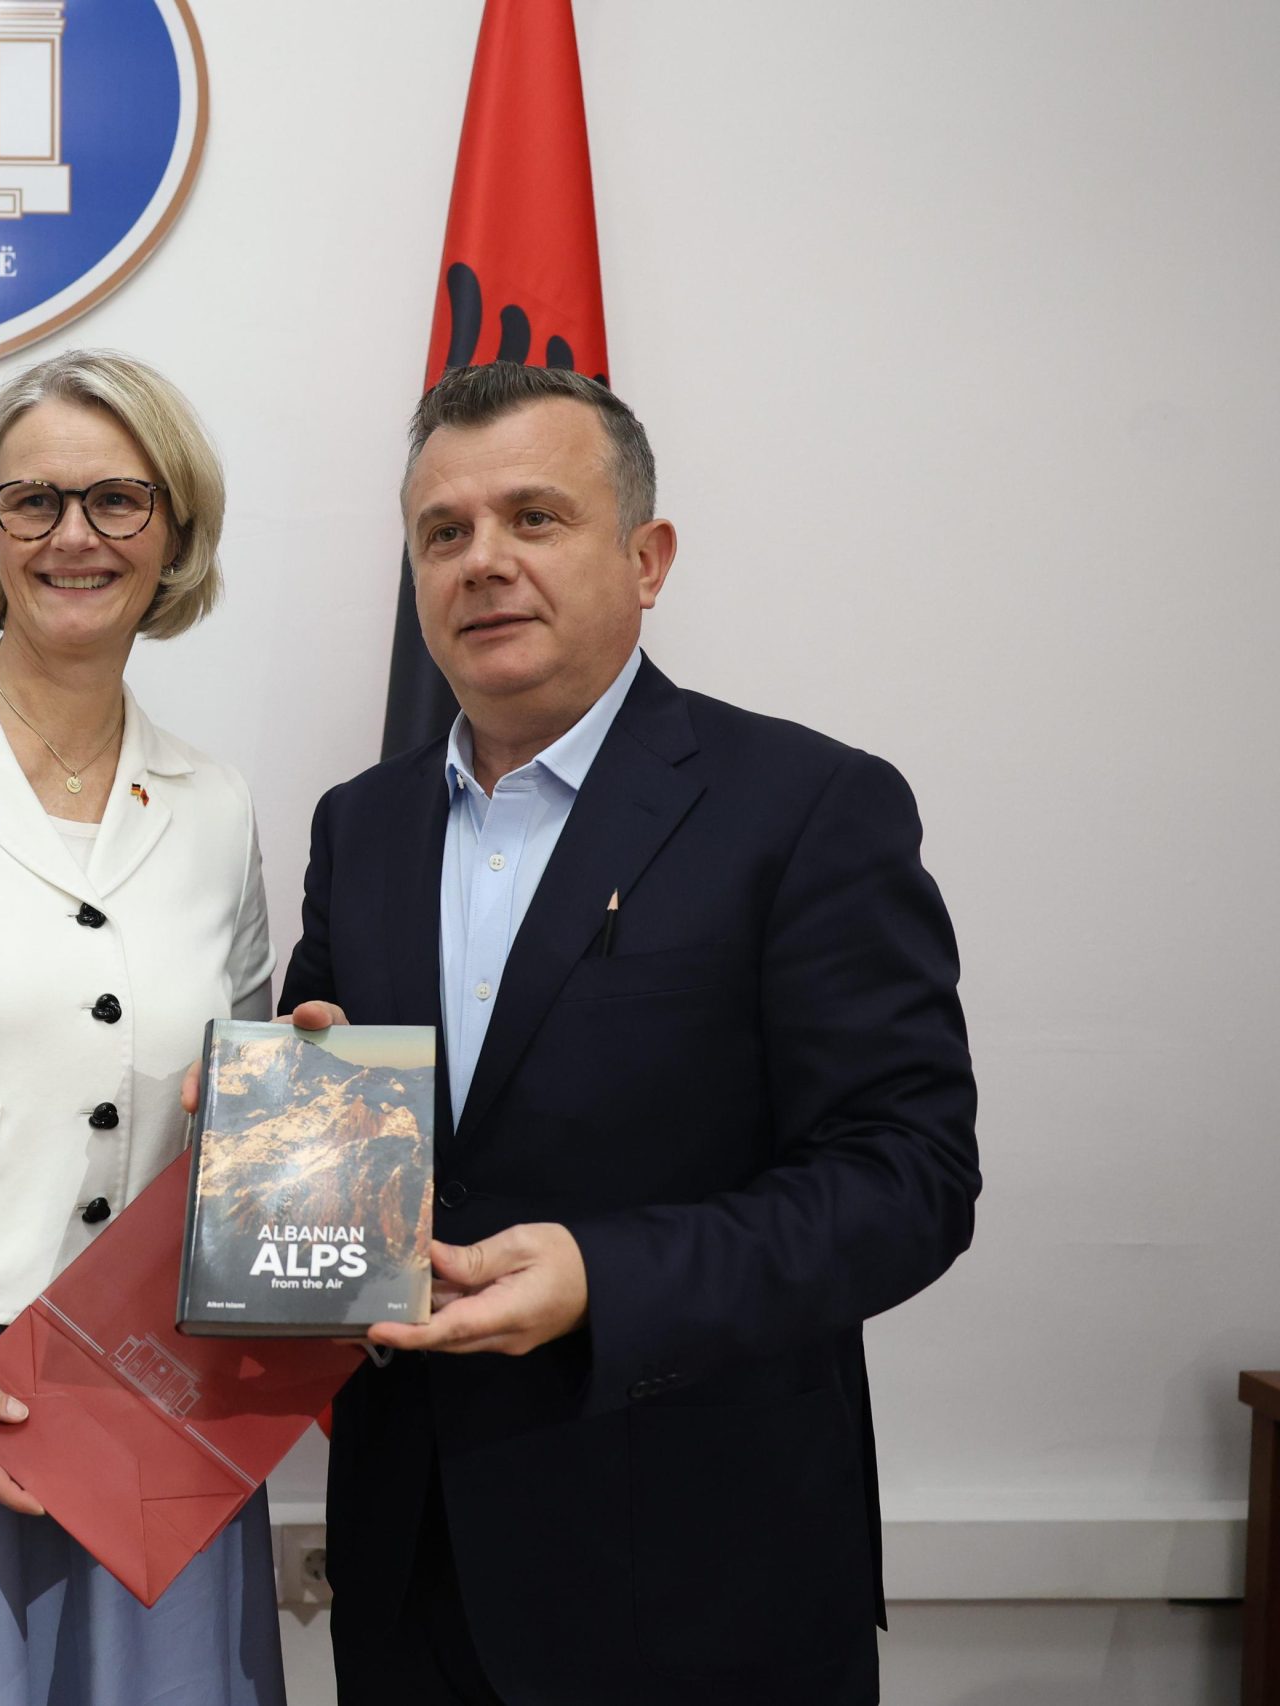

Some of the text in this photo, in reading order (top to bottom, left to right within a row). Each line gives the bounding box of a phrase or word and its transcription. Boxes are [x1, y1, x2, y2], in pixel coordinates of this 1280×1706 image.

[257, 1224, 365, 1243] ALBANIAN
[249, 1243, 368, 1277] ALPS
[271, 1278, 343, 1290] from the Air
